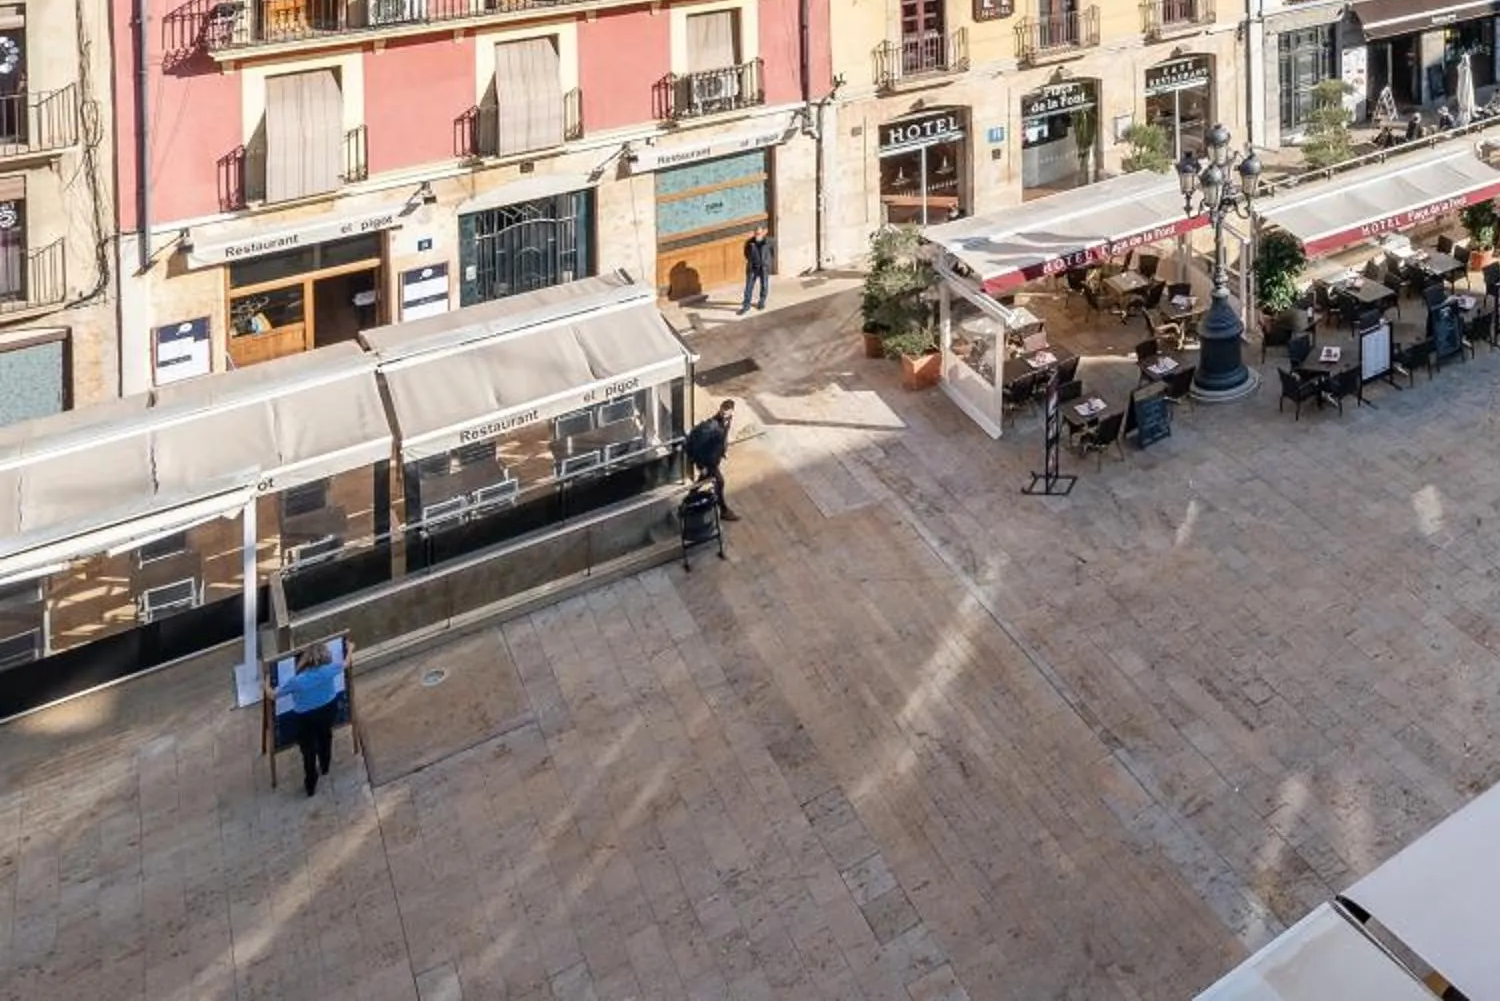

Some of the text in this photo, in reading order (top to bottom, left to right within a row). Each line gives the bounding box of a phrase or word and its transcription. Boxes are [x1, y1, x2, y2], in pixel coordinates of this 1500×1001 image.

[888, 116, 960, 143] HOTEL
[225, 234, 299, 258] Restaurant
[460, 377, 640, 443] Restaurant el pigot
